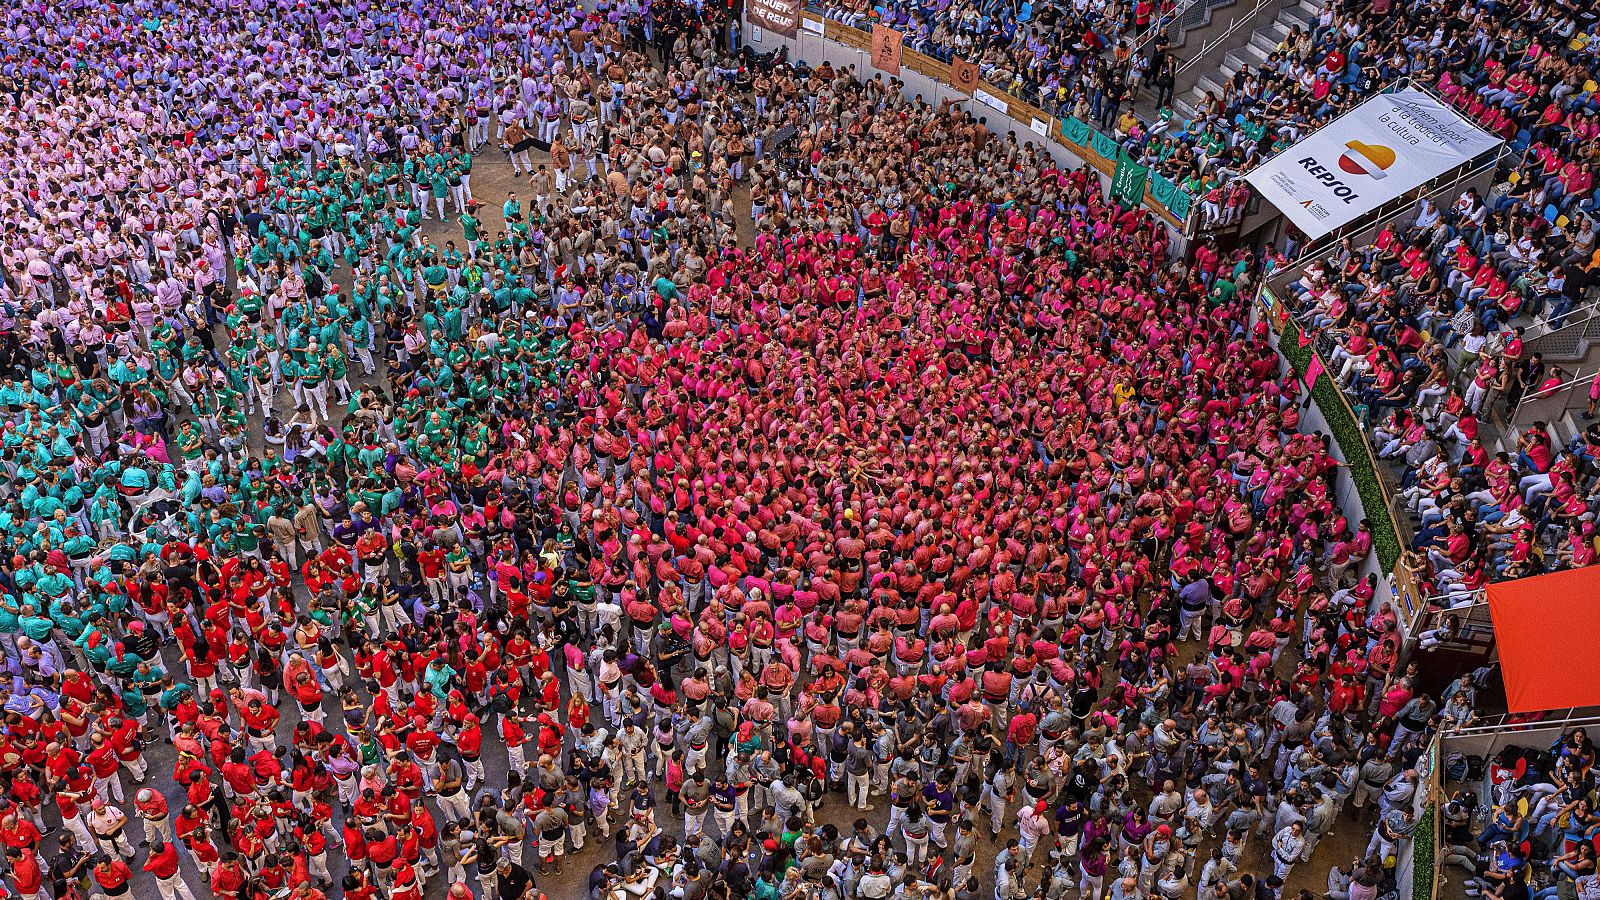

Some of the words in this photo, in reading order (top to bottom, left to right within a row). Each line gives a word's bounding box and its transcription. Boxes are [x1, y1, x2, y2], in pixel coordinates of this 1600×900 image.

[752, 6, 767, 18] DE
[766, 12, 794, 28] REUS
[1364, 80, 1372, 89] 8
[1378, 112, 1391, 123] la
[1387, 121, 1420, 146] cultura
[1398, 109, 1410, 120] la
[1408, 117, 1444, 144] tradició
[1405, 102, 1438, 126] Donem
[1434, 122, 1468, 145] suport
[1298, 156, 1359, 205] REPSOL
